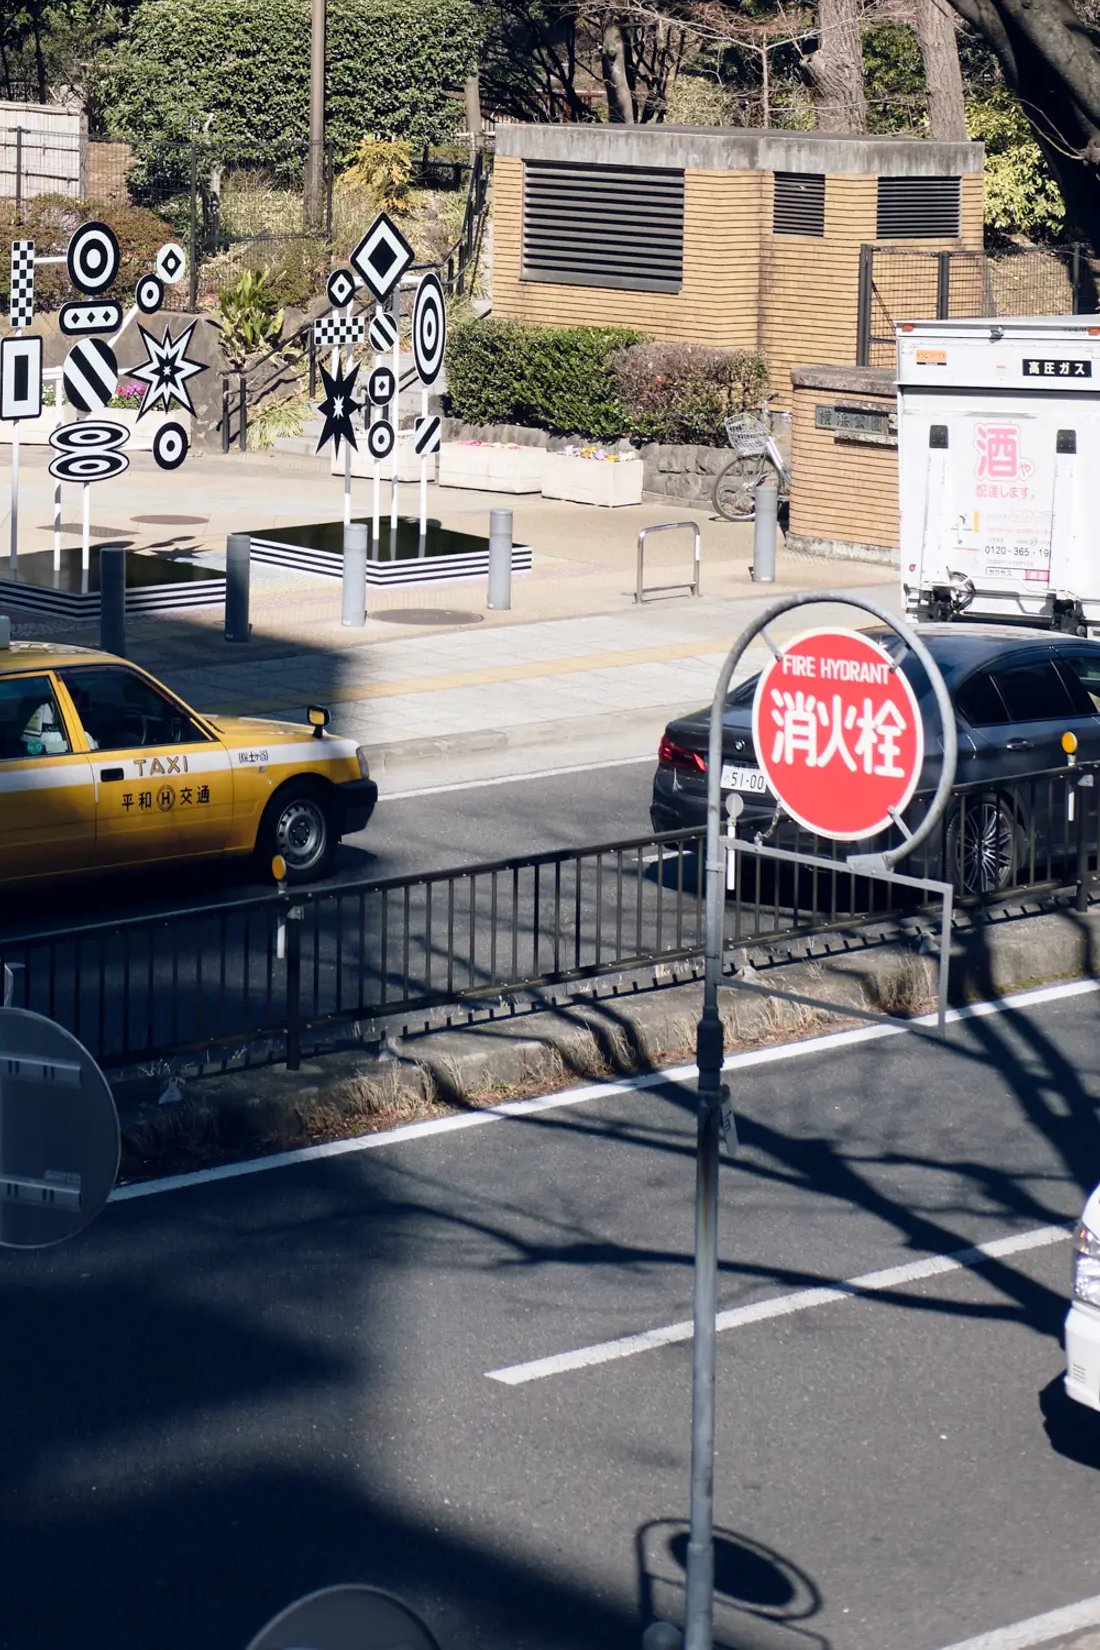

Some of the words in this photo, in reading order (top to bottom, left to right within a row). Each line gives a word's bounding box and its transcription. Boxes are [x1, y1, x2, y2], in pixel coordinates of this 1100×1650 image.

[1028, 361, 1085, 375] 高圧ガス
[976, 427, 1031, 477] 酒や
[984, 545, 1049, 558] 0120-365-19
[782, 653, 816, 678] FIRE
[820, 657, 889, 685] HYDRANT
[770, 688, 907, 778] 消火栓
[133, 755, 189, 777] TAXI
